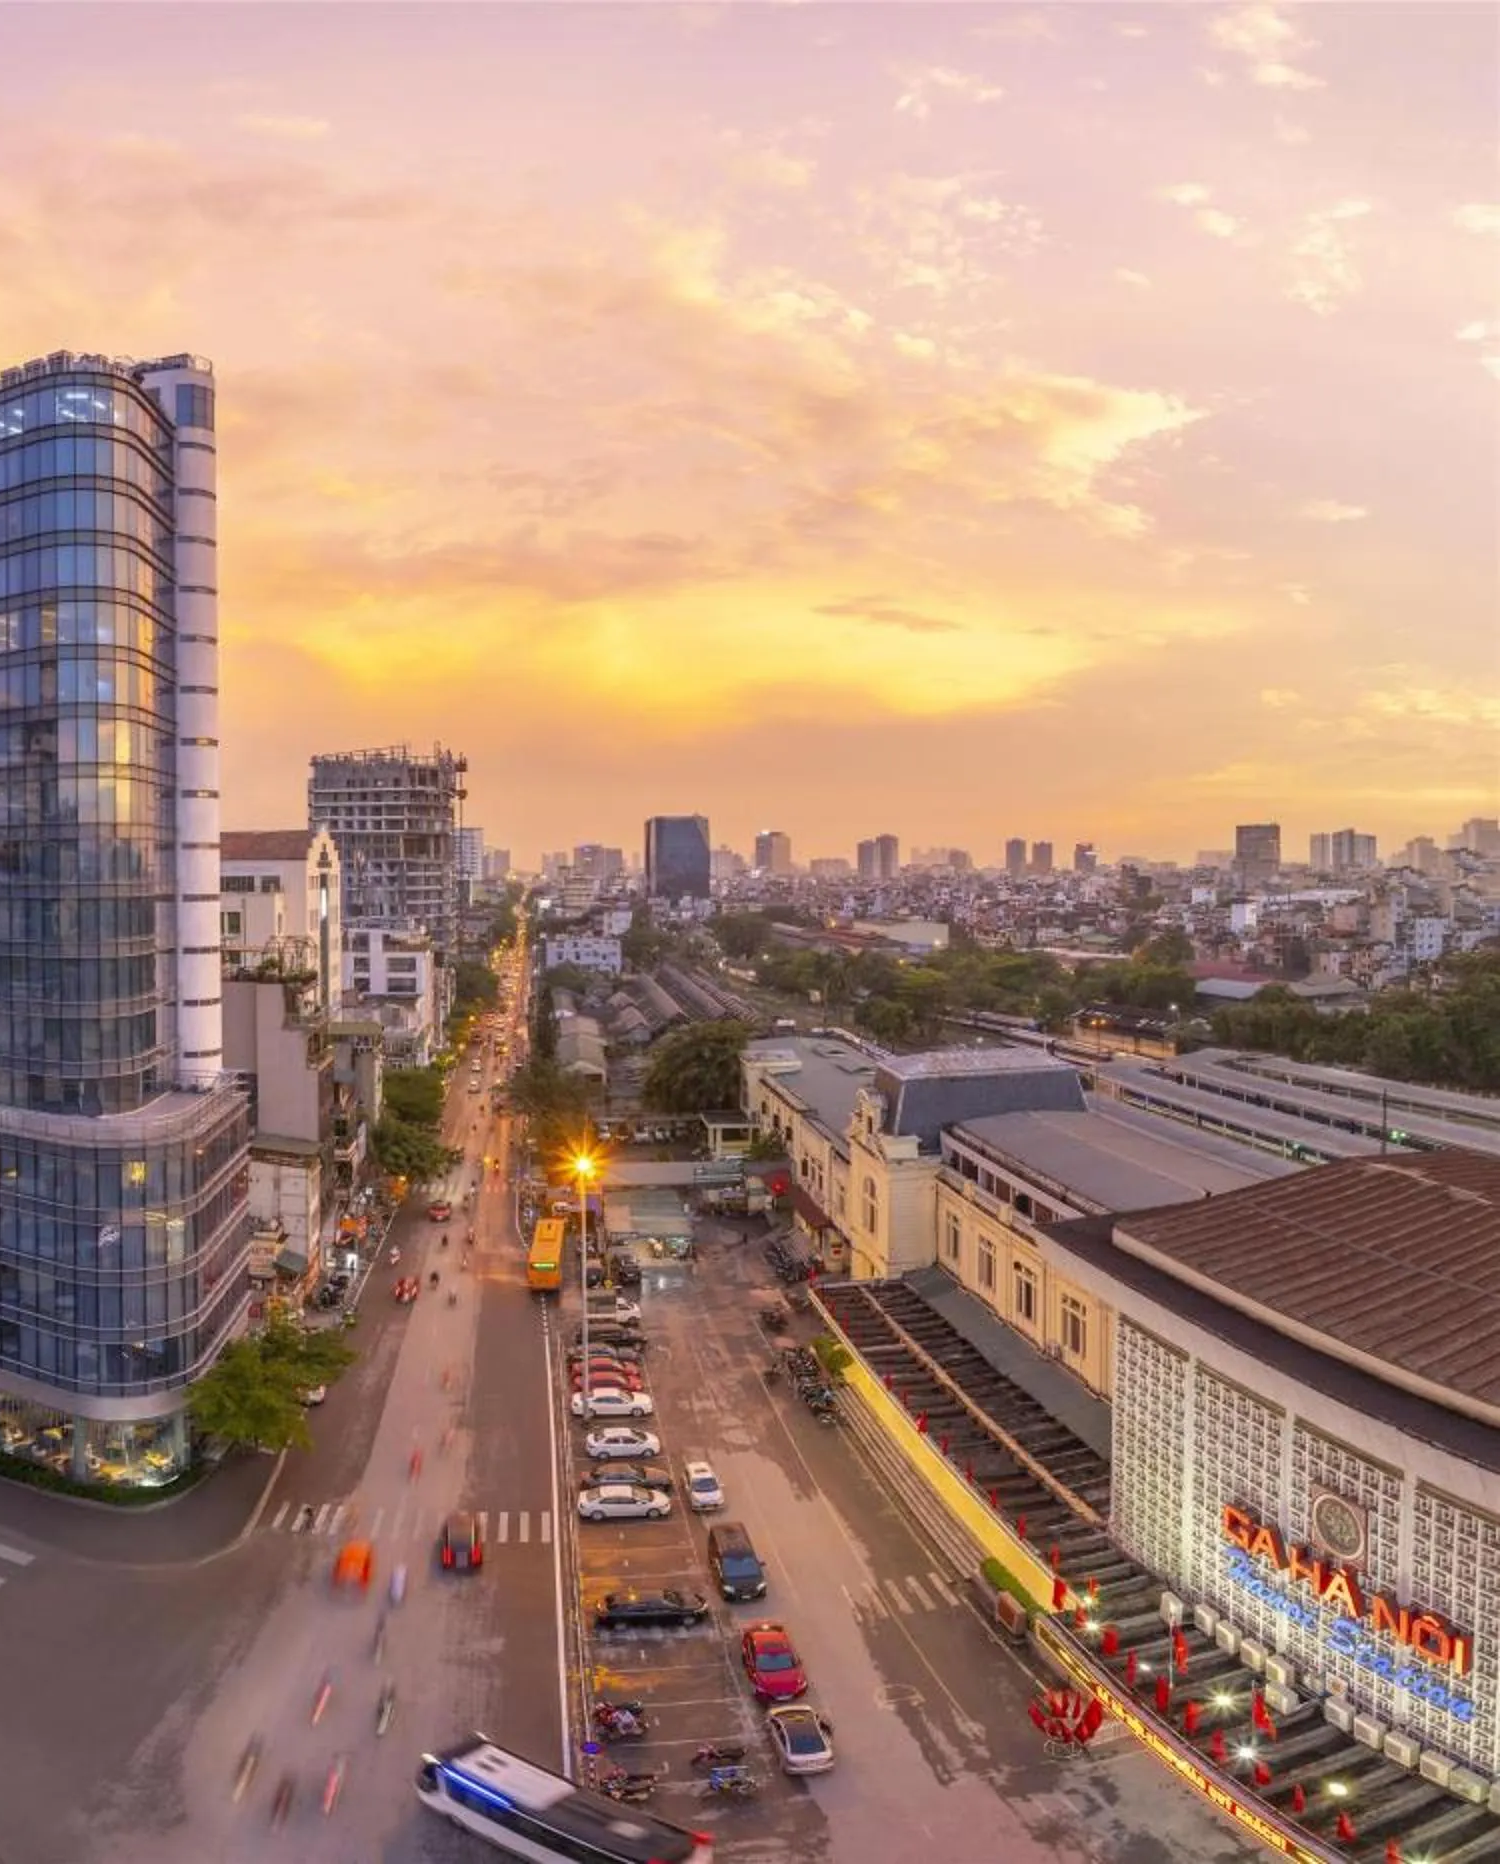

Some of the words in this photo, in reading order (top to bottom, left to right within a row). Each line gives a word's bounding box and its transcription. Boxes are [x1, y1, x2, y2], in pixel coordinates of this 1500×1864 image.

[1223, 1503, 1282, 1569] GA
[1289, 1543, 1361, 1618] HÀ
[1371, 1595, 1473, 1678] NỘI
